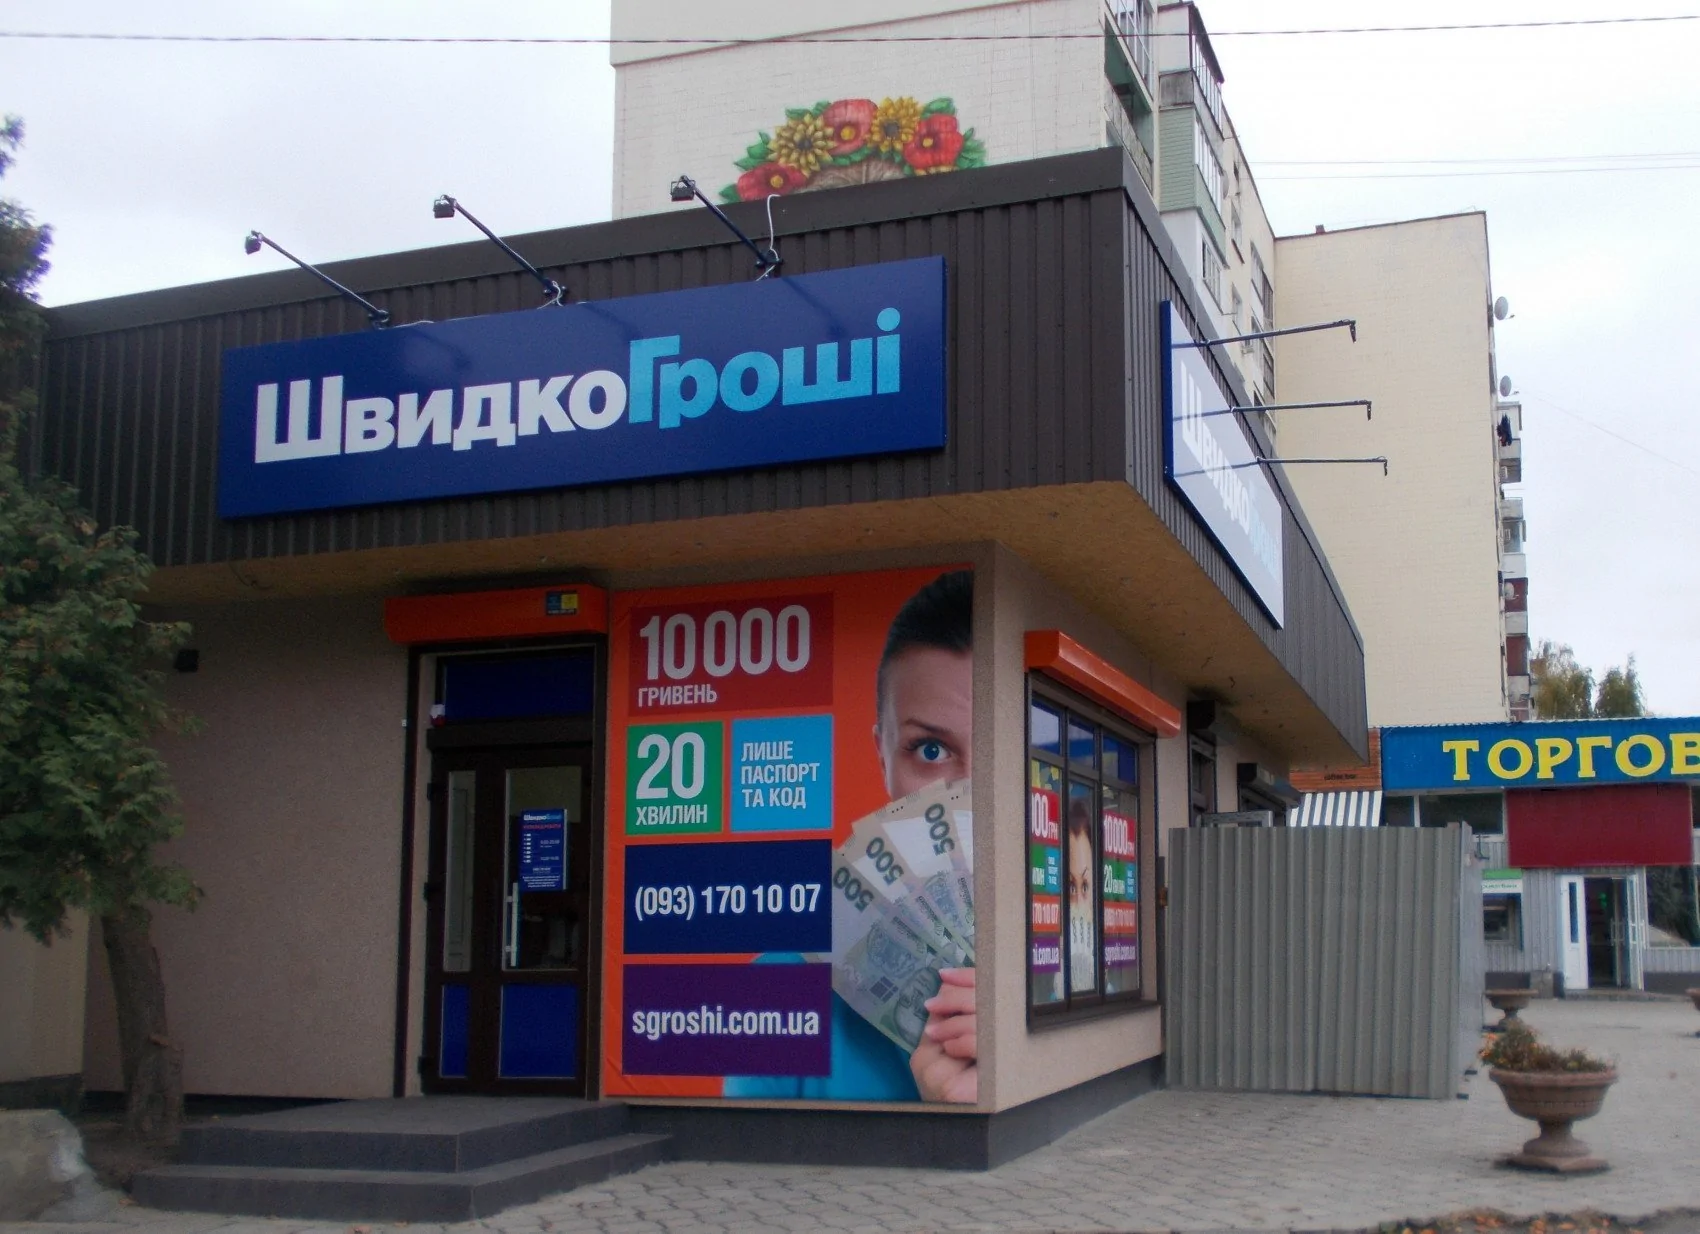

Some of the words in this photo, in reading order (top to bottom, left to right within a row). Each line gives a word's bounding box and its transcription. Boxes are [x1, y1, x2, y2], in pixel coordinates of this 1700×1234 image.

[255, 307, 900, 463] ШвидкоГроші
[638, 684, 718, 708] ГРИВЕНЬ
[636, 732, 705, 800] 20
[741, 741, 793, 761] ЛИШЕ
[1443, 733, 1700, 781] ТОРГОВ
[741, 763, 820, 784] ПАСПОРТ
[636, 804, 708, 826] ХВИЛИН
[742, 789, 764, 807] ТА
[770, 787, 806, 809] КОД
[924, 803, 955, 856] 500
[866, 837, 904, 886] 500
[635, 886, 695, 921] (093)
[701, 886, 746, 914] 170
[752, 884, 783, 913] 10
[790, 884, 821, 913] 07
[833, 866, 874, 912] 500
[632, 1005, 820, 1040] sgroshi.com.ua
